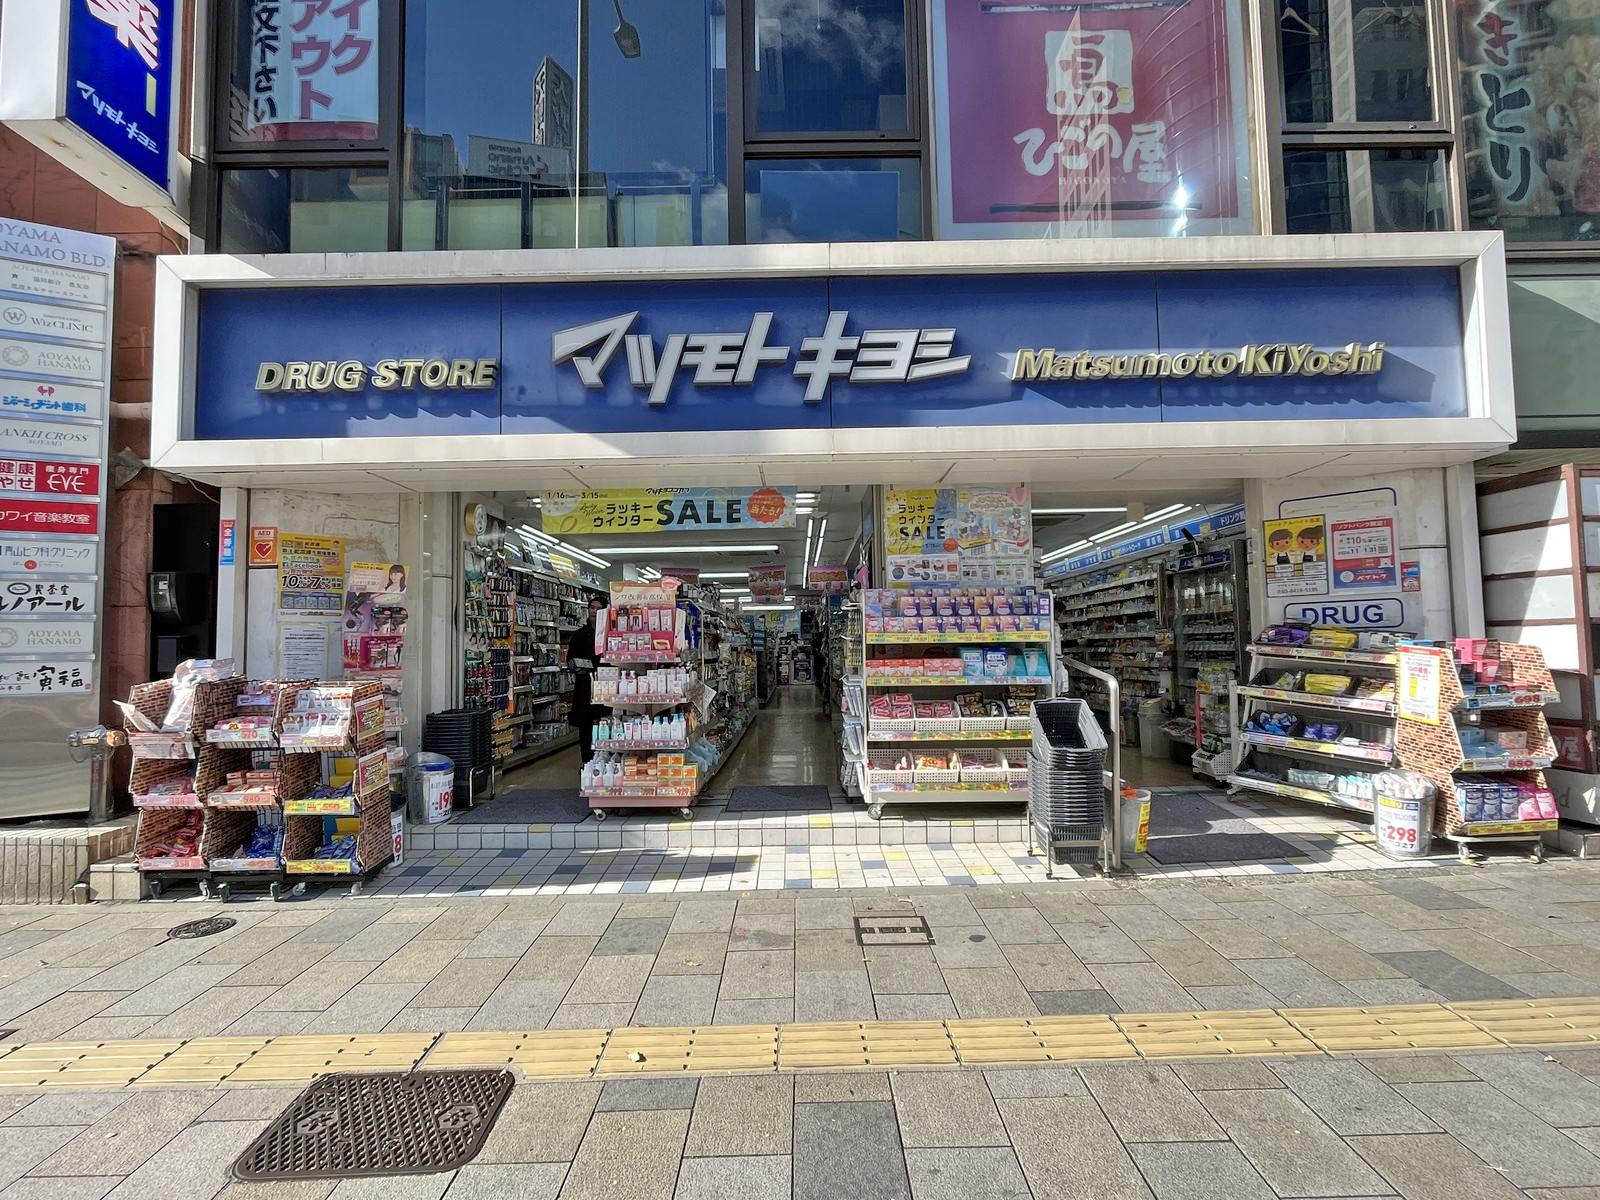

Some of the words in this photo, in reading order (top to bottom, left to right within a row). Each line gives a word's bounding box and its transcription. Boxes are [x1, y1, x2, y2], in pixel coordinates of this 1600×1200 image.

[76, 80, 159, 154] マツモトキヨシ
[1013, 120, 1172, 183] ひごの屋
[70, 252, 110, 269] BLD.
[38, 351, 90, 364] AOYAMA
[552, 310, 971, 406] マツモトキヨシ
[37, 359, 91, 371] HANAMO
[255, 360, 366, 394] DRUG
[372, 357, 499, 390] STORE
[45, 430, 89, 443] CROSS
[47, 473, 86, 492] EVE
[606, 502, 653, 515] ラッキー
[656, 499, 742, 526] SALE
[898, 503, 935, 514] ラッキー
[593, 515, 653, 528] ウィンター
[898, 514, 945, 525] ウィンター
[899, 526, 946, 540] SALE
[1302, 604, 1384, 625] DRUG
[27, 630, 81, 638] AOYAMA
[27, 637, 82, 646] HANAMO
[1514, 694, 1542, 704] 698
[1387, 825, 1417, 842] 298
